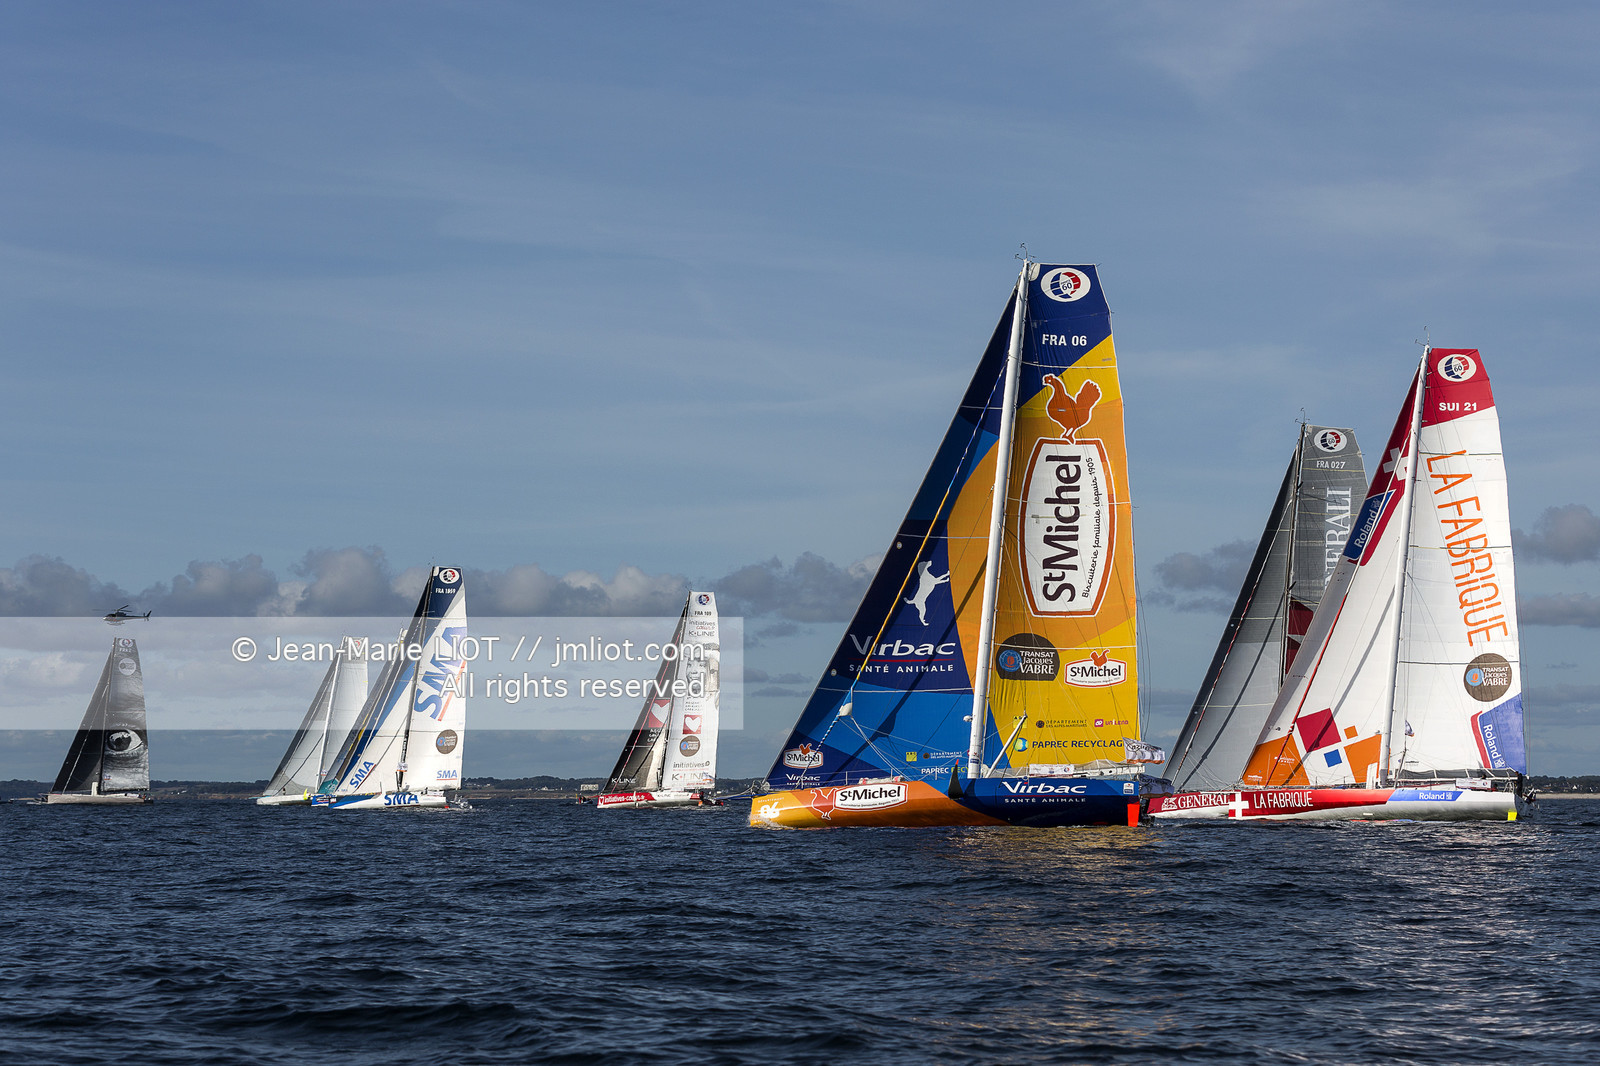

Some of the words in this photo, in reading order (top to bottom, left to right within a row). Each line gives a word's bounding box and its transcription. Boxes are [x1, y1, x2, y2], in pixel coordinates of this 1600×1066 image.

[1042, 333, 1067, 346] FRA
[1071, 335, 1088, 347] 06
[1438, 402, 1460, 412] SUI
[1463, 402, 1477, 411] 21
[1085, 457, 1096, 476] 1905
[1316, 460, 1330, 469] FRA
[1330, 461, 1346, 469] 027
[1426, 450, 1472, 495] LA
[1353, 509, 1379, 548] Roland
[1437, 496, 1509, 647] FABRIQUE
[849, 634, 956, 656] Virbac
[1019, 650, 1055, 658] TRANSAT
[849, 664, 889, 673] SANTÉ
[896, 664, 954, 673] ANIMALE
[1023, 658, 1053, 666] Jacques
[414, 627, 467, 719] SMA
[1020, 664, 1054, 675] VABRE
[1482, 677, 1508, 686] VABRE
[1032, 740, 1068, 748] PAPREC
[1071, 740, 1124, 748] RECYCLAG
[1483, 723, 1501, 760] Roland
[349, 761, 374, 788] SMA
[436, 770, 458, 779] SMA
[1002, 781, 1087, 794] Virbac
[384, 792, 419, 806] SMA
[1253, 793, 1266, 809] LA
[1266, 791, 1314, 808] FABRIQUE
